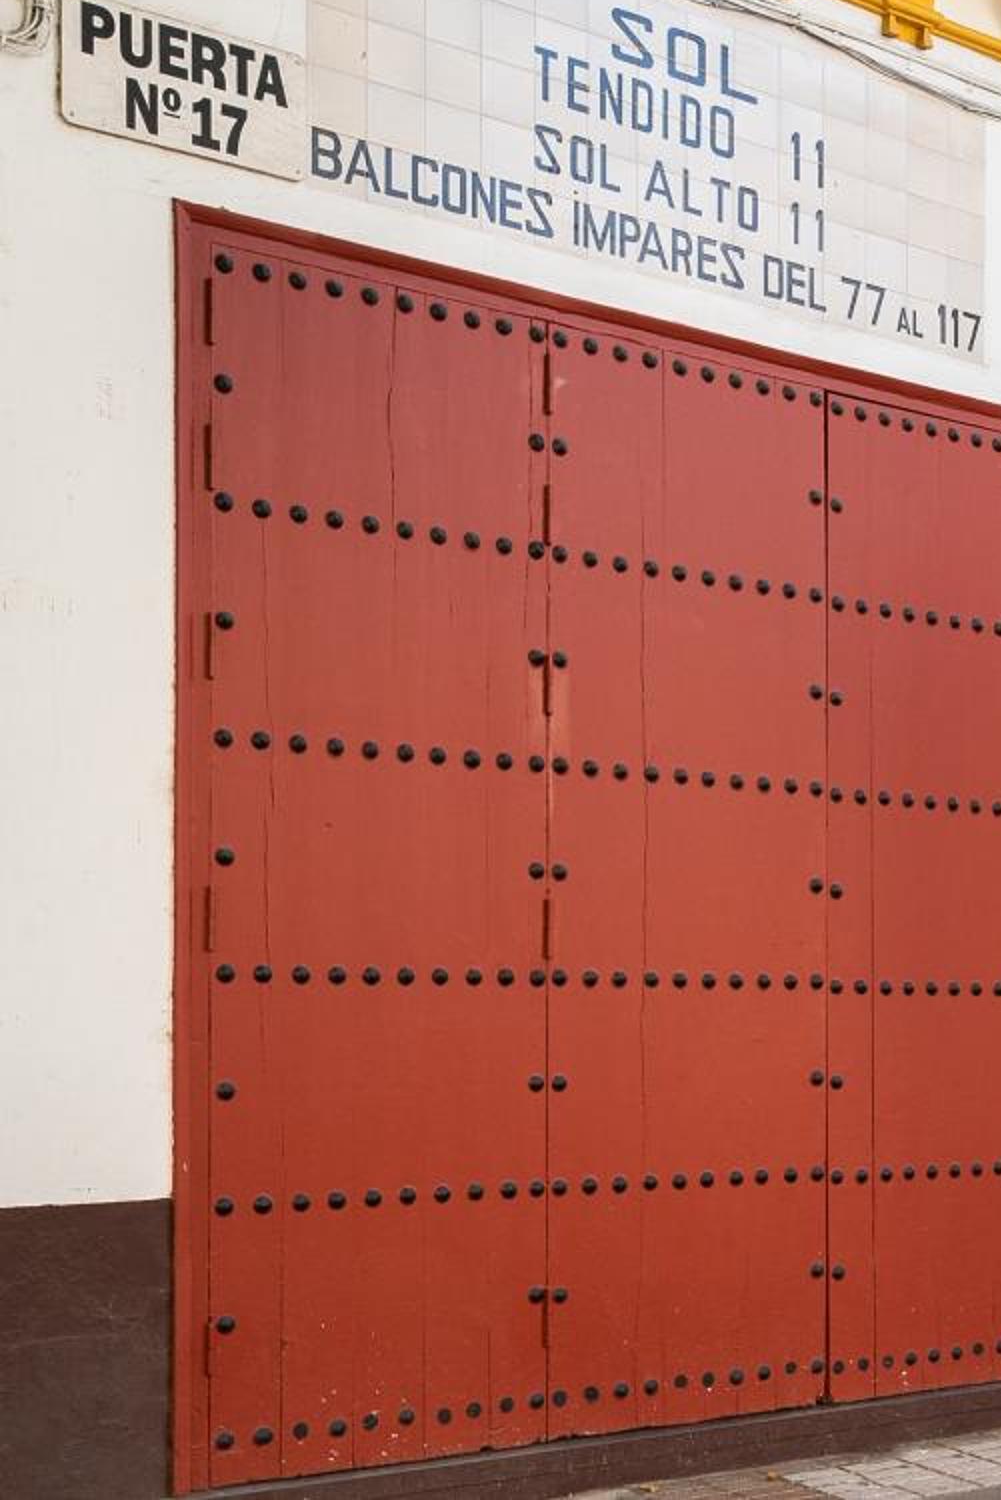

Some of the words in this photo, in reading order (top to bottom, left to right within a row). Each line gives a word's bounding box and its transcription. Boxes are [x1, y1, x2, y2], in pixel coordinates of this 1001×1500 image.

[80, 1, 289, 108] PUERTA
[610, 7, 758, 105] SOL
[191, 97, 248, 156] 17
[534, 45, 735, 159] TENDIDO
[790, 131, 825, 189] 11
[311, 126, 555, 237] BALCONES
[763, 254, 827, 313] DEL
[841, 276, 887, 326] 77
[896, 306, 924, 339] AL
[937, 303, 982, 352] 117
[534, 125, 621, 192] SOL
[645, 159, 759, 232] ALTO
[790, 201, 825, 252] 11
